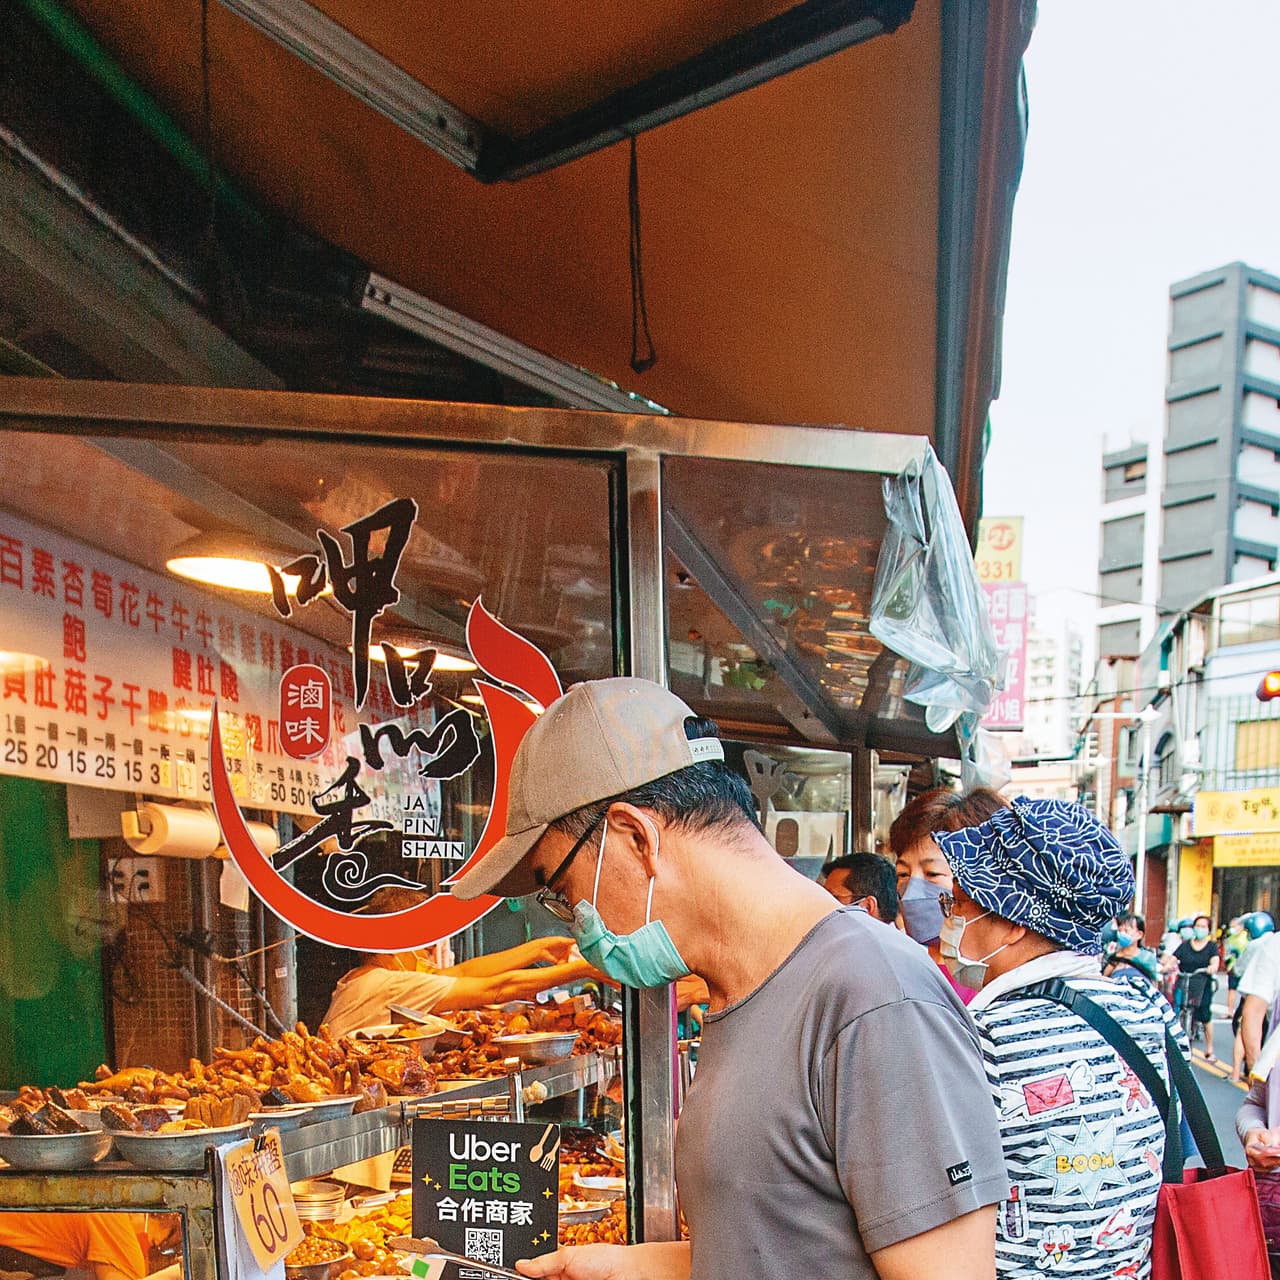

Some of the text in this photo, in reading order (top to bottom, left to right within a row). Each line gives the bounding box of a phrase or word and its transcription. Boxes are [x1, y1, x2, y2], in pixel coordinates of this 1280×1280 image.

[285, 679, 325, 745] 滷味
[5, 738, 28, 765] 25
[36, 744, 58, 769] 20
[67, 749, 87, 774] 15
[95, 754, 116, 779] 25
[124, 759, 143, 783] 15
[404, 795, 425, 811] JA
[404, 818, 436, 834] PIN
[403, 841, 464, 858] SHAIN
[449, 1132, 521, 1162] Uber
[1056, 1151, 1114, 1174] BOOM
[449, 1163, 520, 1193] Eats
[249, 1182, 288, 1254] 60
[436, 1196, 533, 1226] 合作商家
